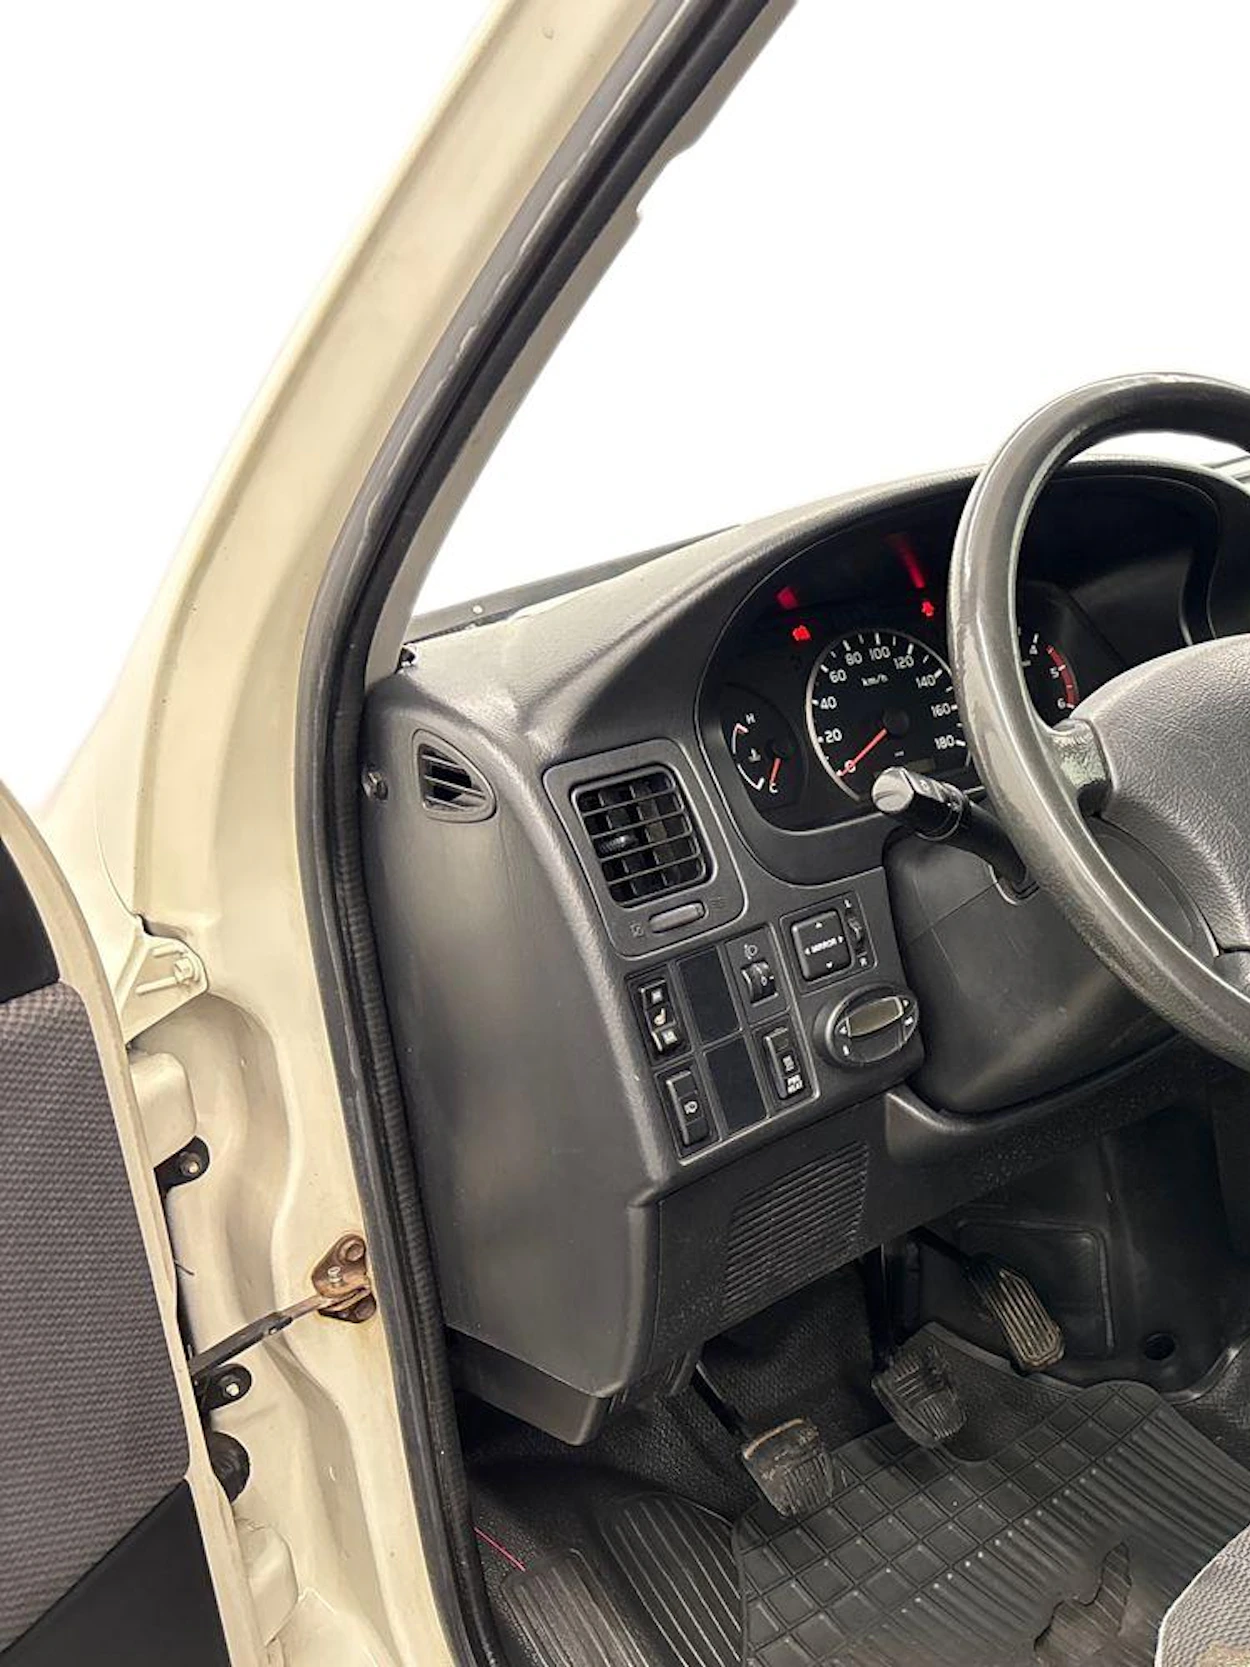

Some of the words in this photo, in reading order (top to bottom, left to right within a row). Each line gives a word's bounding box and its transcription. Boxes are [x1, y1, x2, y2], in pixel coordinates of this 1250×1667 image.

[845, 651, 863, 667] 80
[869, 646, 891, 661] 100
[893, 655, 915, 670] 120
[829, 668, 848, 684] 60
[1049, 666, 1060, 679] 5
[916, 674, 936, 689] 140
[820, 696, 838, 710] 40
[931, 703, 951, 718] 160
[1057, 698, 1066, 709] 6
[745, 713, 756, 724] H
[824, 728, 843, 743] 20
[934, 735, 955, 750] 180
